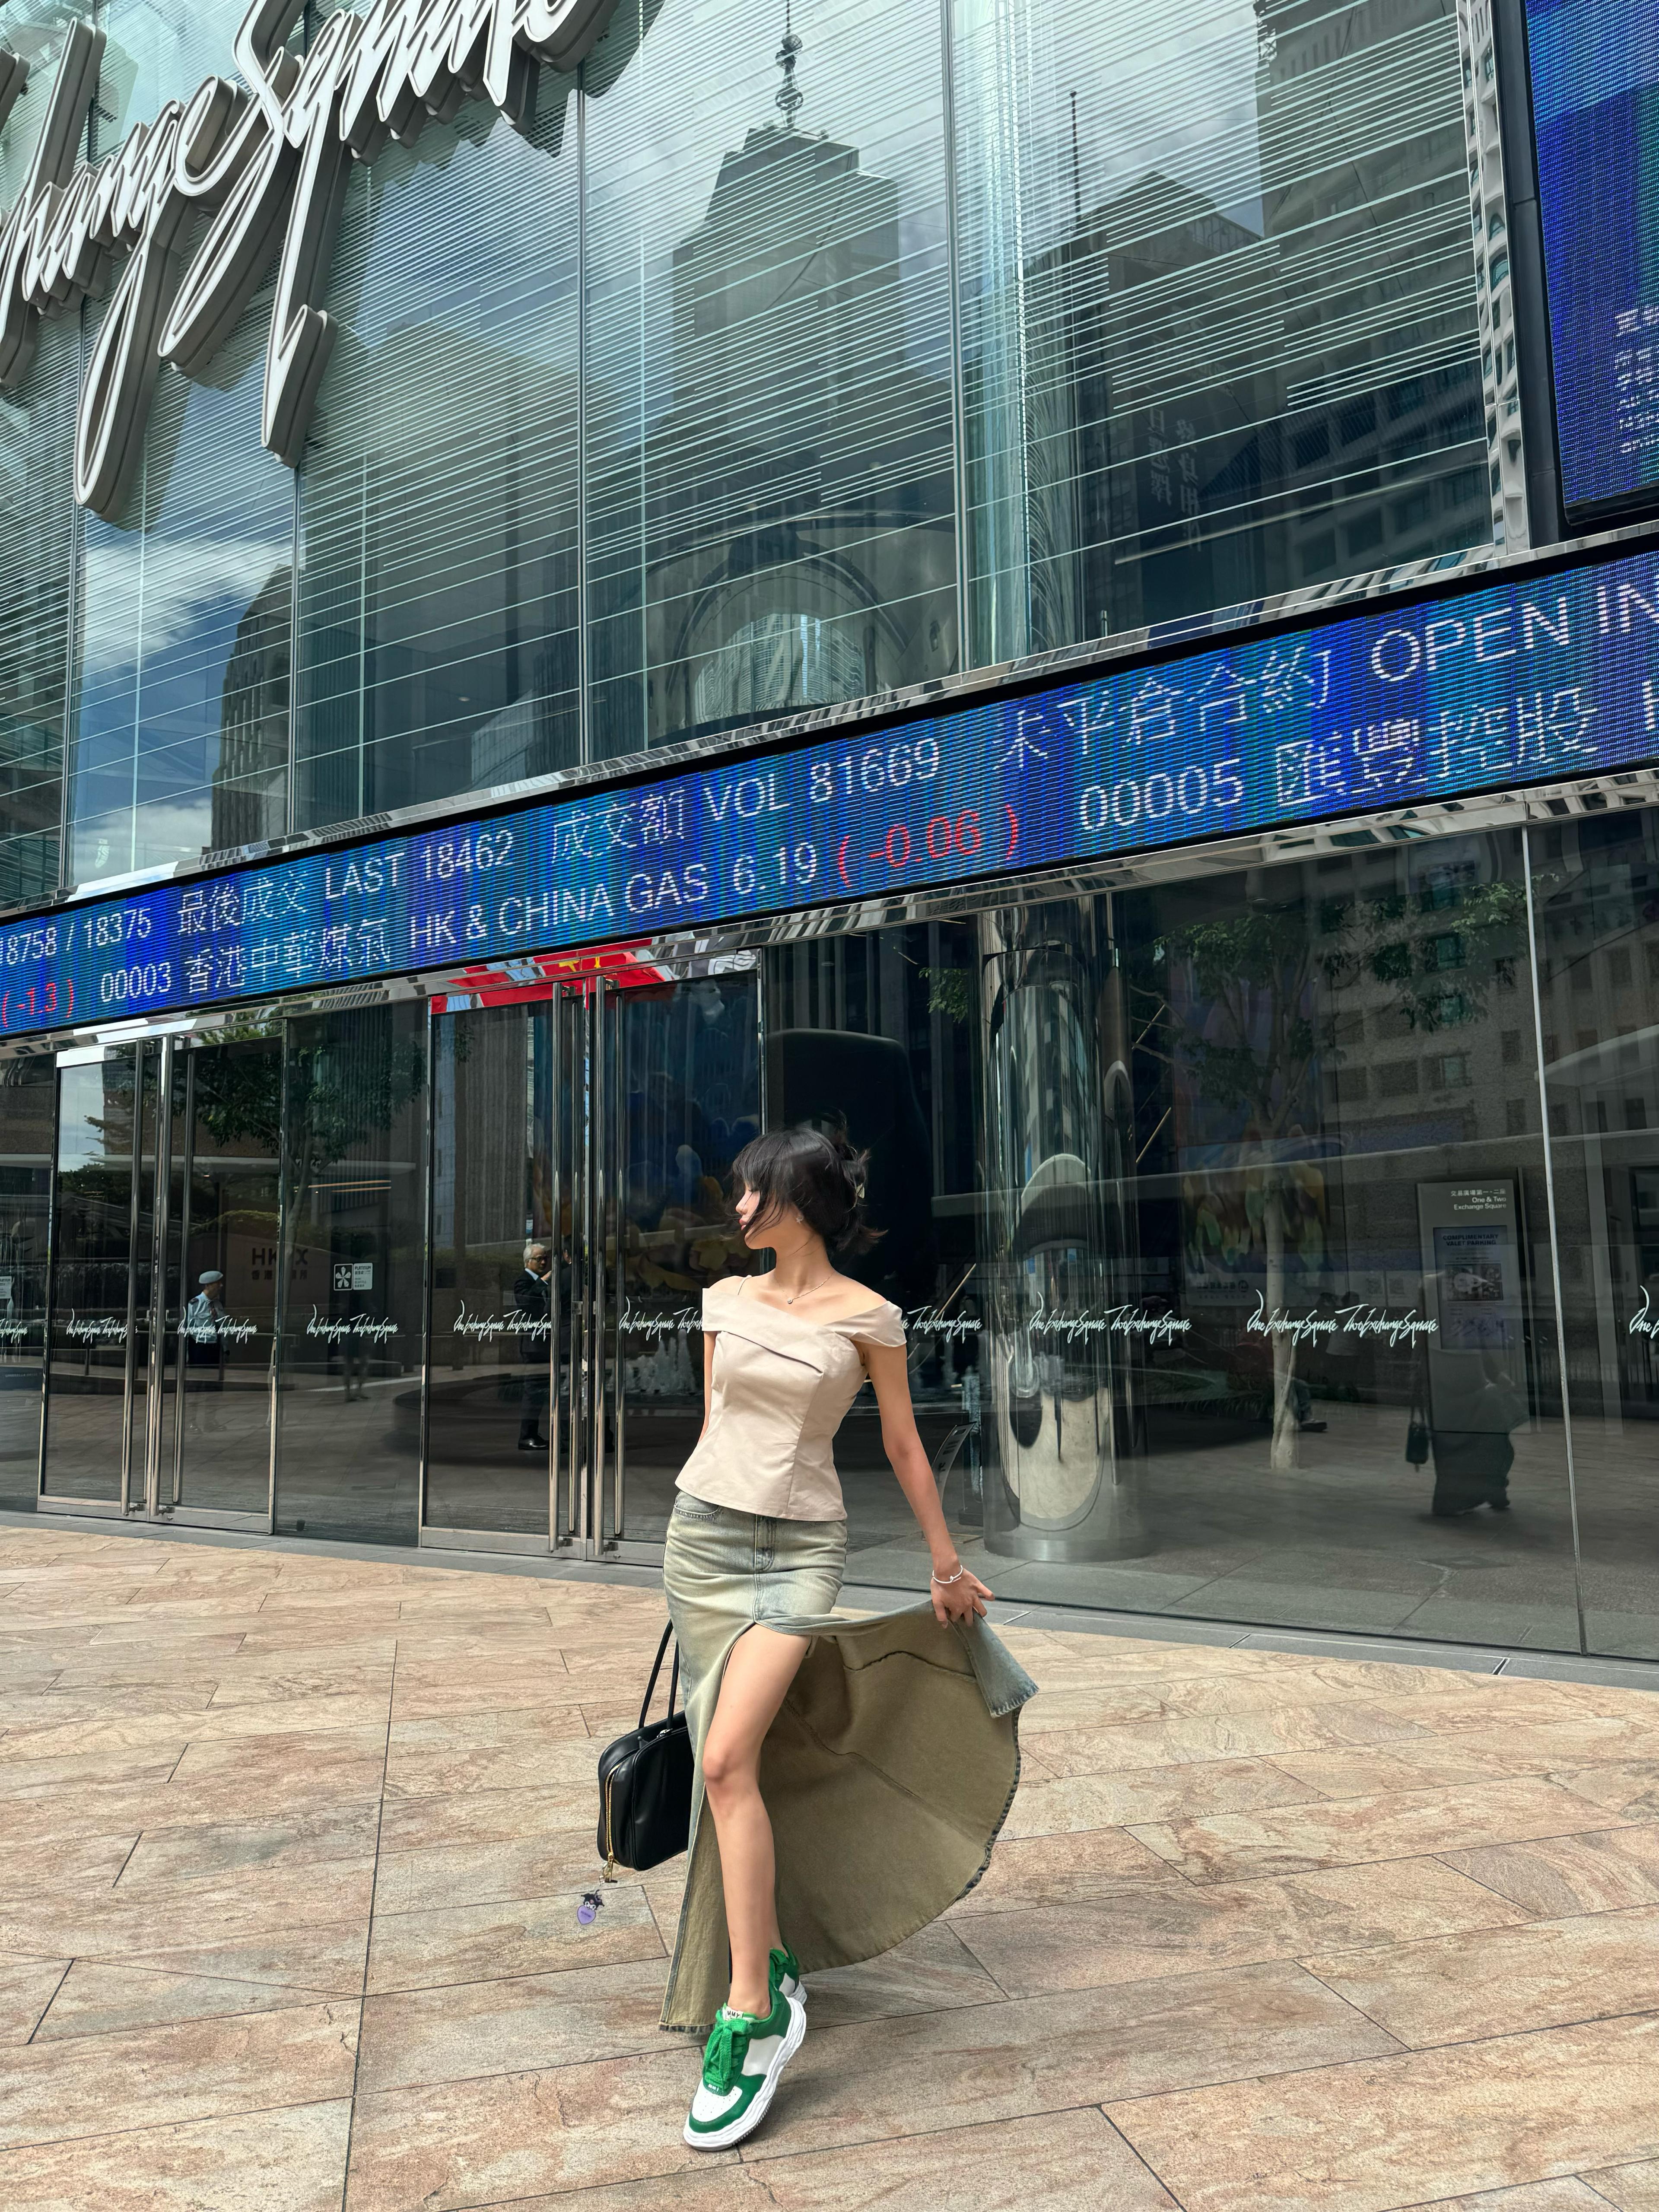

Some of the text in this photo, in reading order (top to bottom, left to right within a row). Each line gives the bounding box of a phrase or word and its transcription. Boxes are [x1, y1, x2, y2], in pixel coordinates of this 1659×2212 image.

[84, 908, 151, 948] 18375
[325, 852, 405, 899] LAST
[421, 830, 514, 881] 18462
[703, 773, 790, 821] VOL
[810, 737, 940, 803] 81669
[1371, 597, 1570, 682] OPEN
[101, 962, 171, 1002] 00003
[410, 910, 457, 948] HK
[466, 905, 488, 940] &
[498, 883, 615, 935] CHINA
[625, 863, 709, 914] GAS
[733, 842, 817, 895] 6.19
[1080, 758, 1243, 830] 00005
[252, 1248, 308, 1265] HKX
